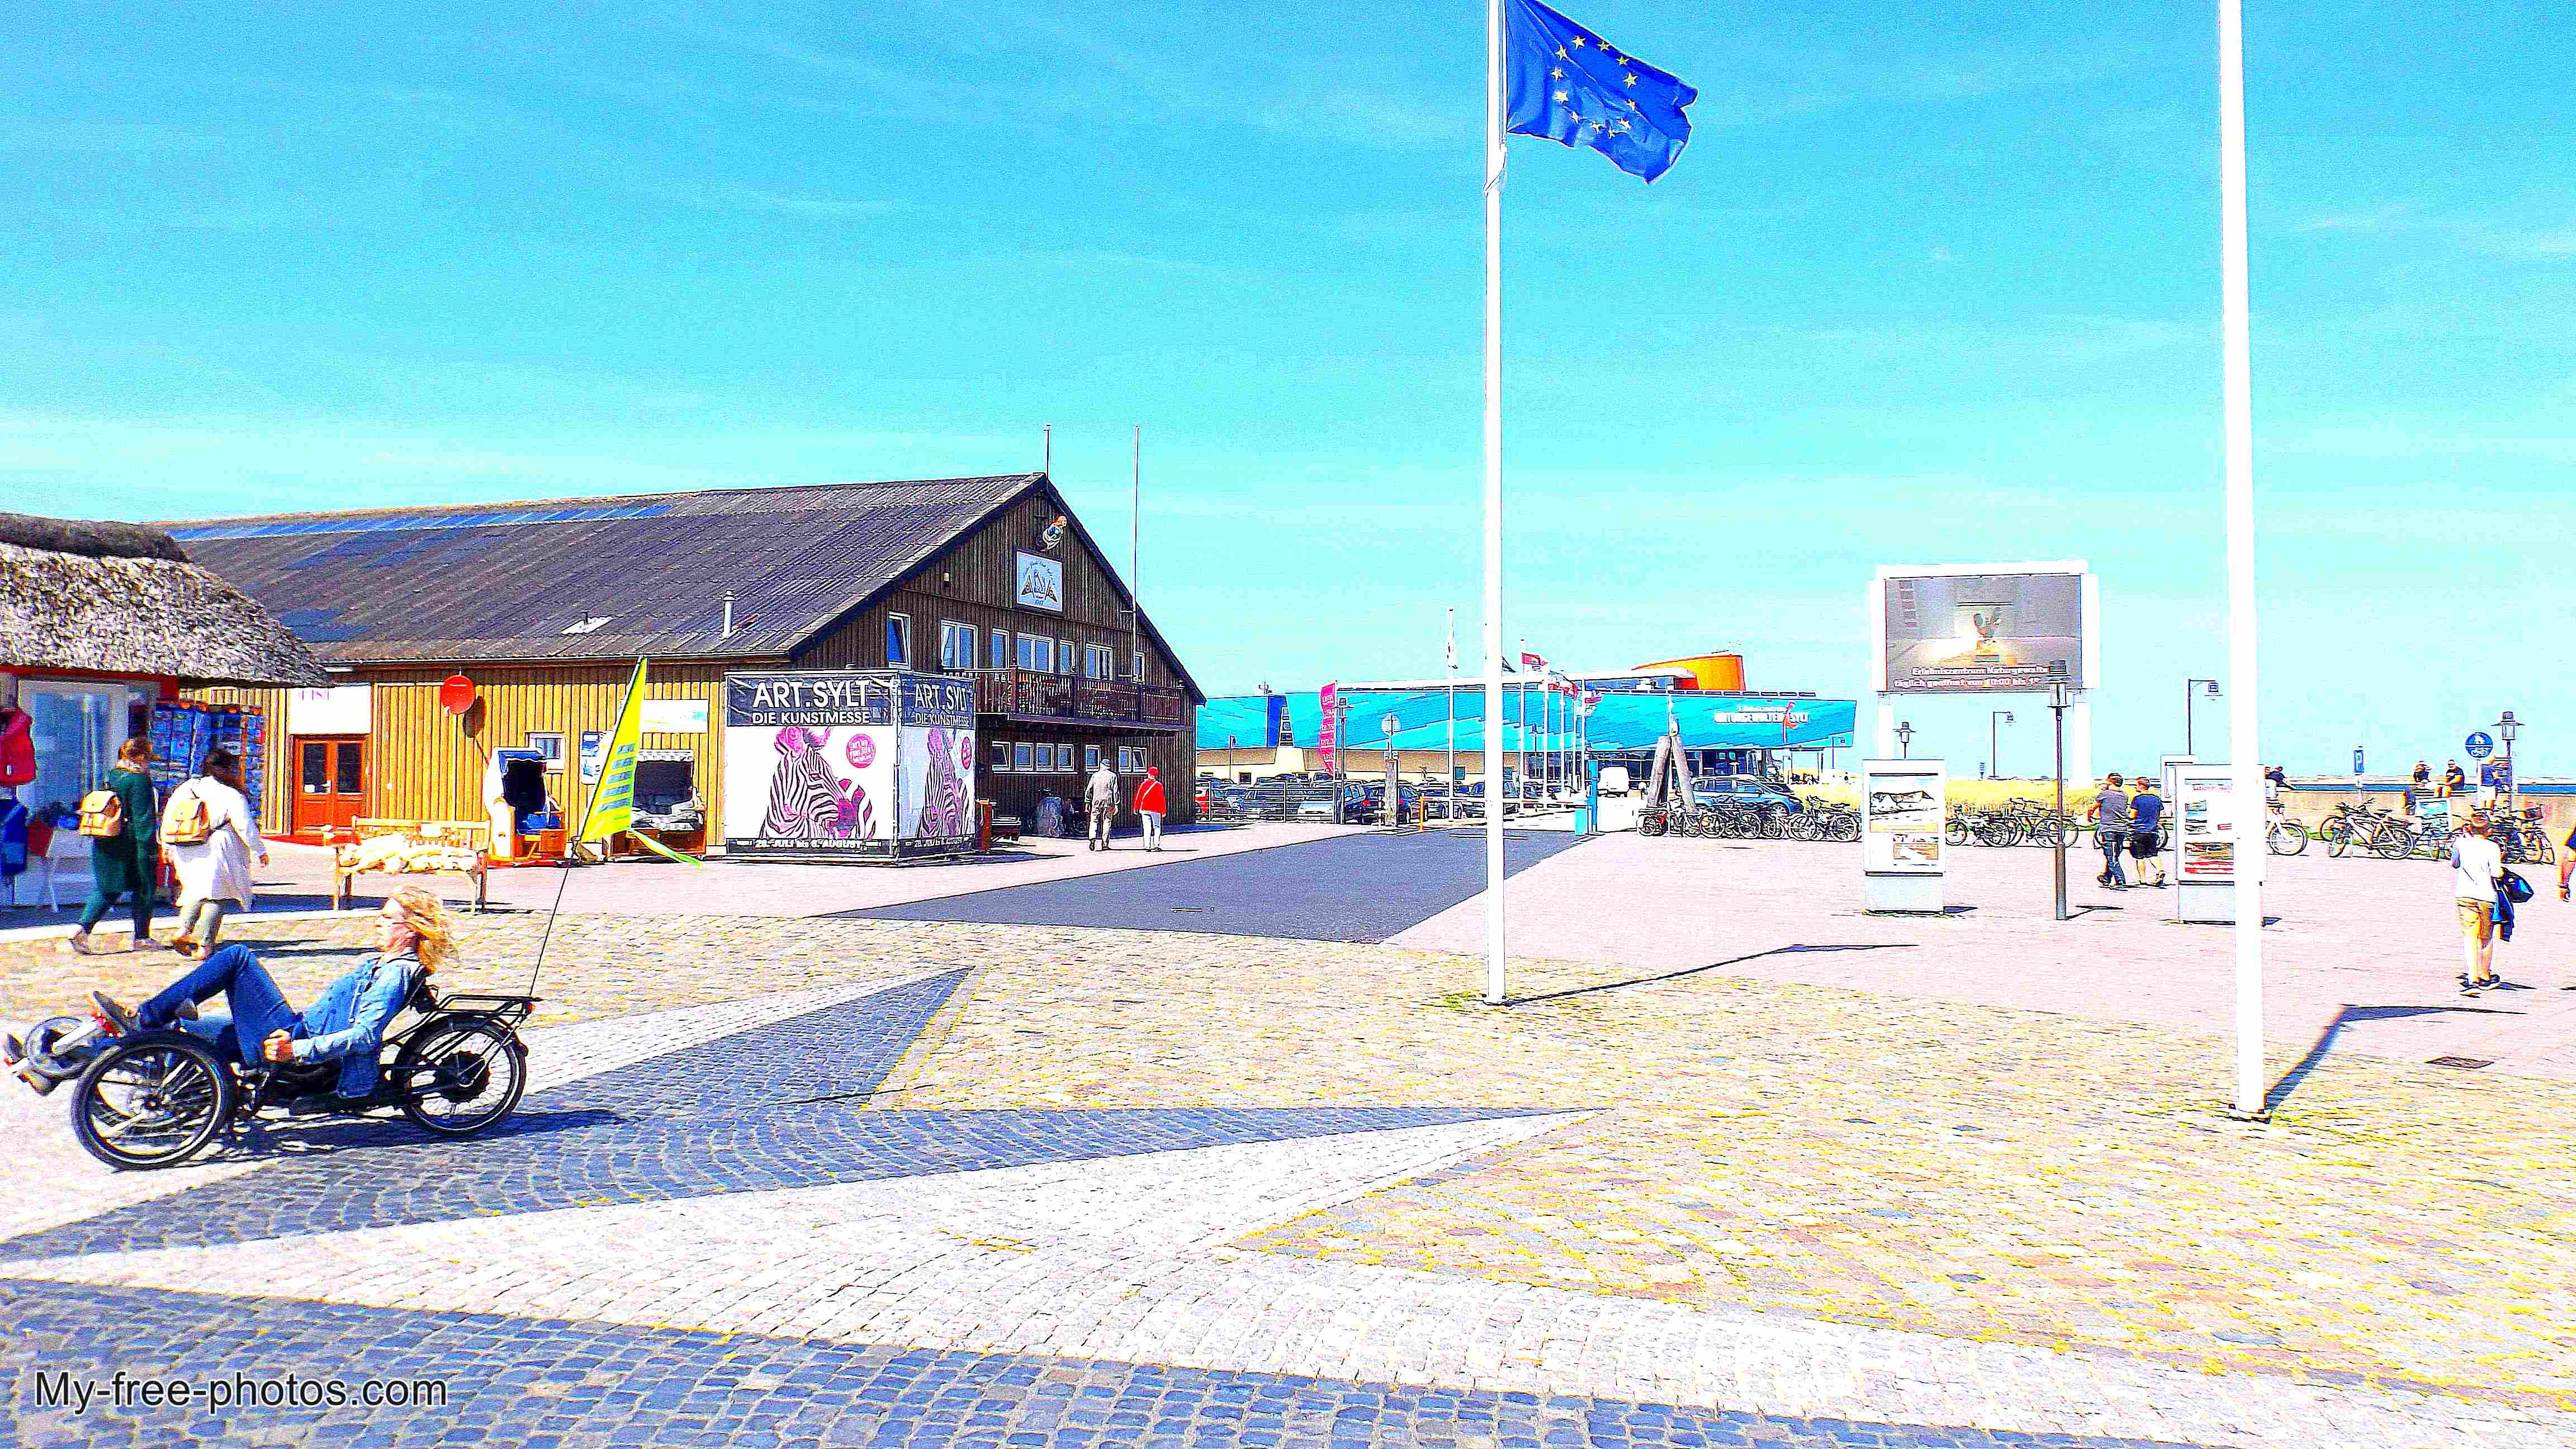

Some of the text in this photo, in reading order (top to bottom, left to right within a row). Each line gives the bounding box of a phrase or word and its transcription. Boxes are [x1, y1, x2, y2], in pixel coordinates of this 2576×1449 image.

[752, 711, 870, 724] DIE KUNSTMESSE
[915, 712, 929, 725] DIE
[822, 839, 862, 848] AUGUST
